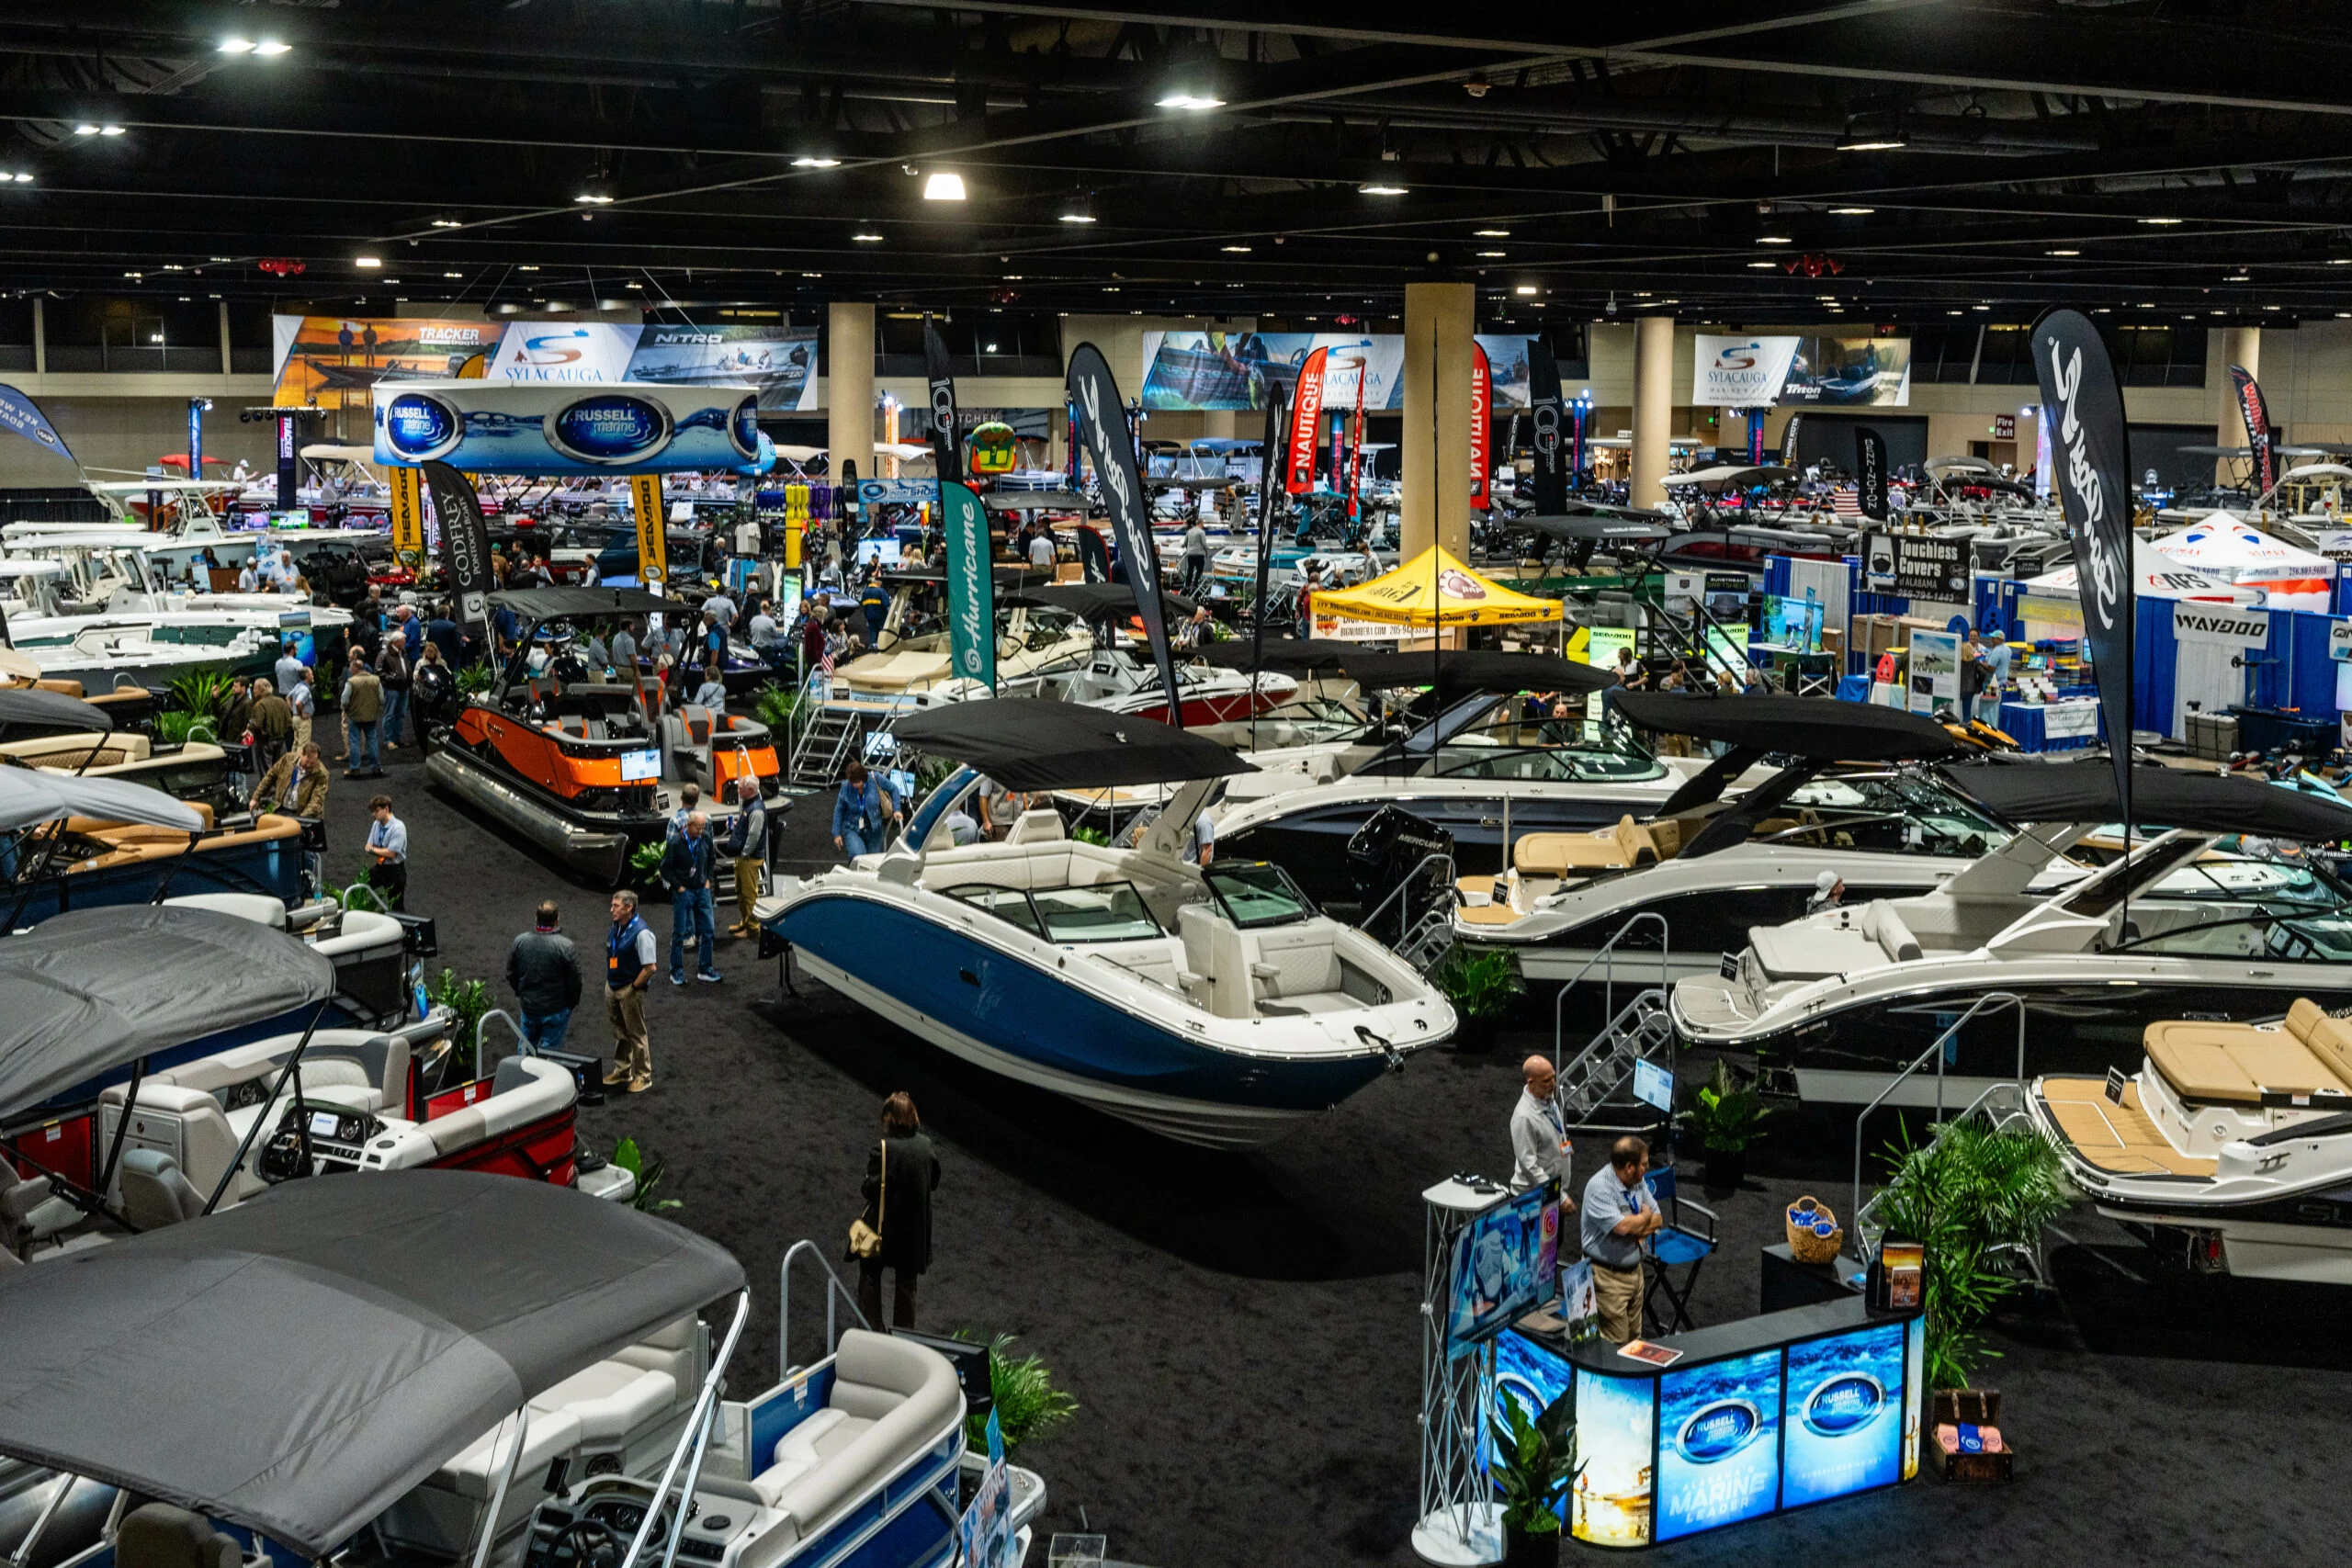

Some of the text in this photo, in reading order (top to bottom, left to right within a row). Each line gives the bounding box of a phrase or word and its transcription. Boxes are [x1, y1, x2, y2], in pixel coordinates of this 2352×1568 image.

[420, 327, 480, 341] TRACKER
[654, 333, 723, 344] NITRO
[1708, 371, 1767, 383] SYLACAUGA
[1785, 383, 1822, 395] Triton
[394, 406, 430, 420] RUSSELL
[574, 409, 636, 422] RUSSELL
[957, 413, 998, 424] TCHEN
[1296, 372, 1320, 468] NAUTIQUE
[1996, 417, 2014, 427] Fire
[403, 419, 431, 431] marine
[594, 422, 636, 433] marine
[1996, 427, 2014, 437] Exit
[283, 416, 293, 459] TRACKER
[1864, 438, 1878, 510] BENNINGTON
[441, 491, 471, 587] GODFREY
[466, 526, 482, 575] PONTOON
[1899, 538, 1958, 560] Touchless
[961, 502, 981, 649] Hurricane
[1899, 557, 1941, 577] Covers
[1905, 578, 1938, 589] ALABAMA
[2161, 572, 2211, 590] AFS
[2175, 614, 2267, 637] WAYDOO
[1397, 833, 1443, 851] MERCURY
[1821, 1387, 1860, 1404] RUSSELL
[1697, 1415, 1736, 1433] RUSSELL
[1668, 1472, 1769, 1517] MARINE
[1685, 1497, 1749, 1524] LEADER
